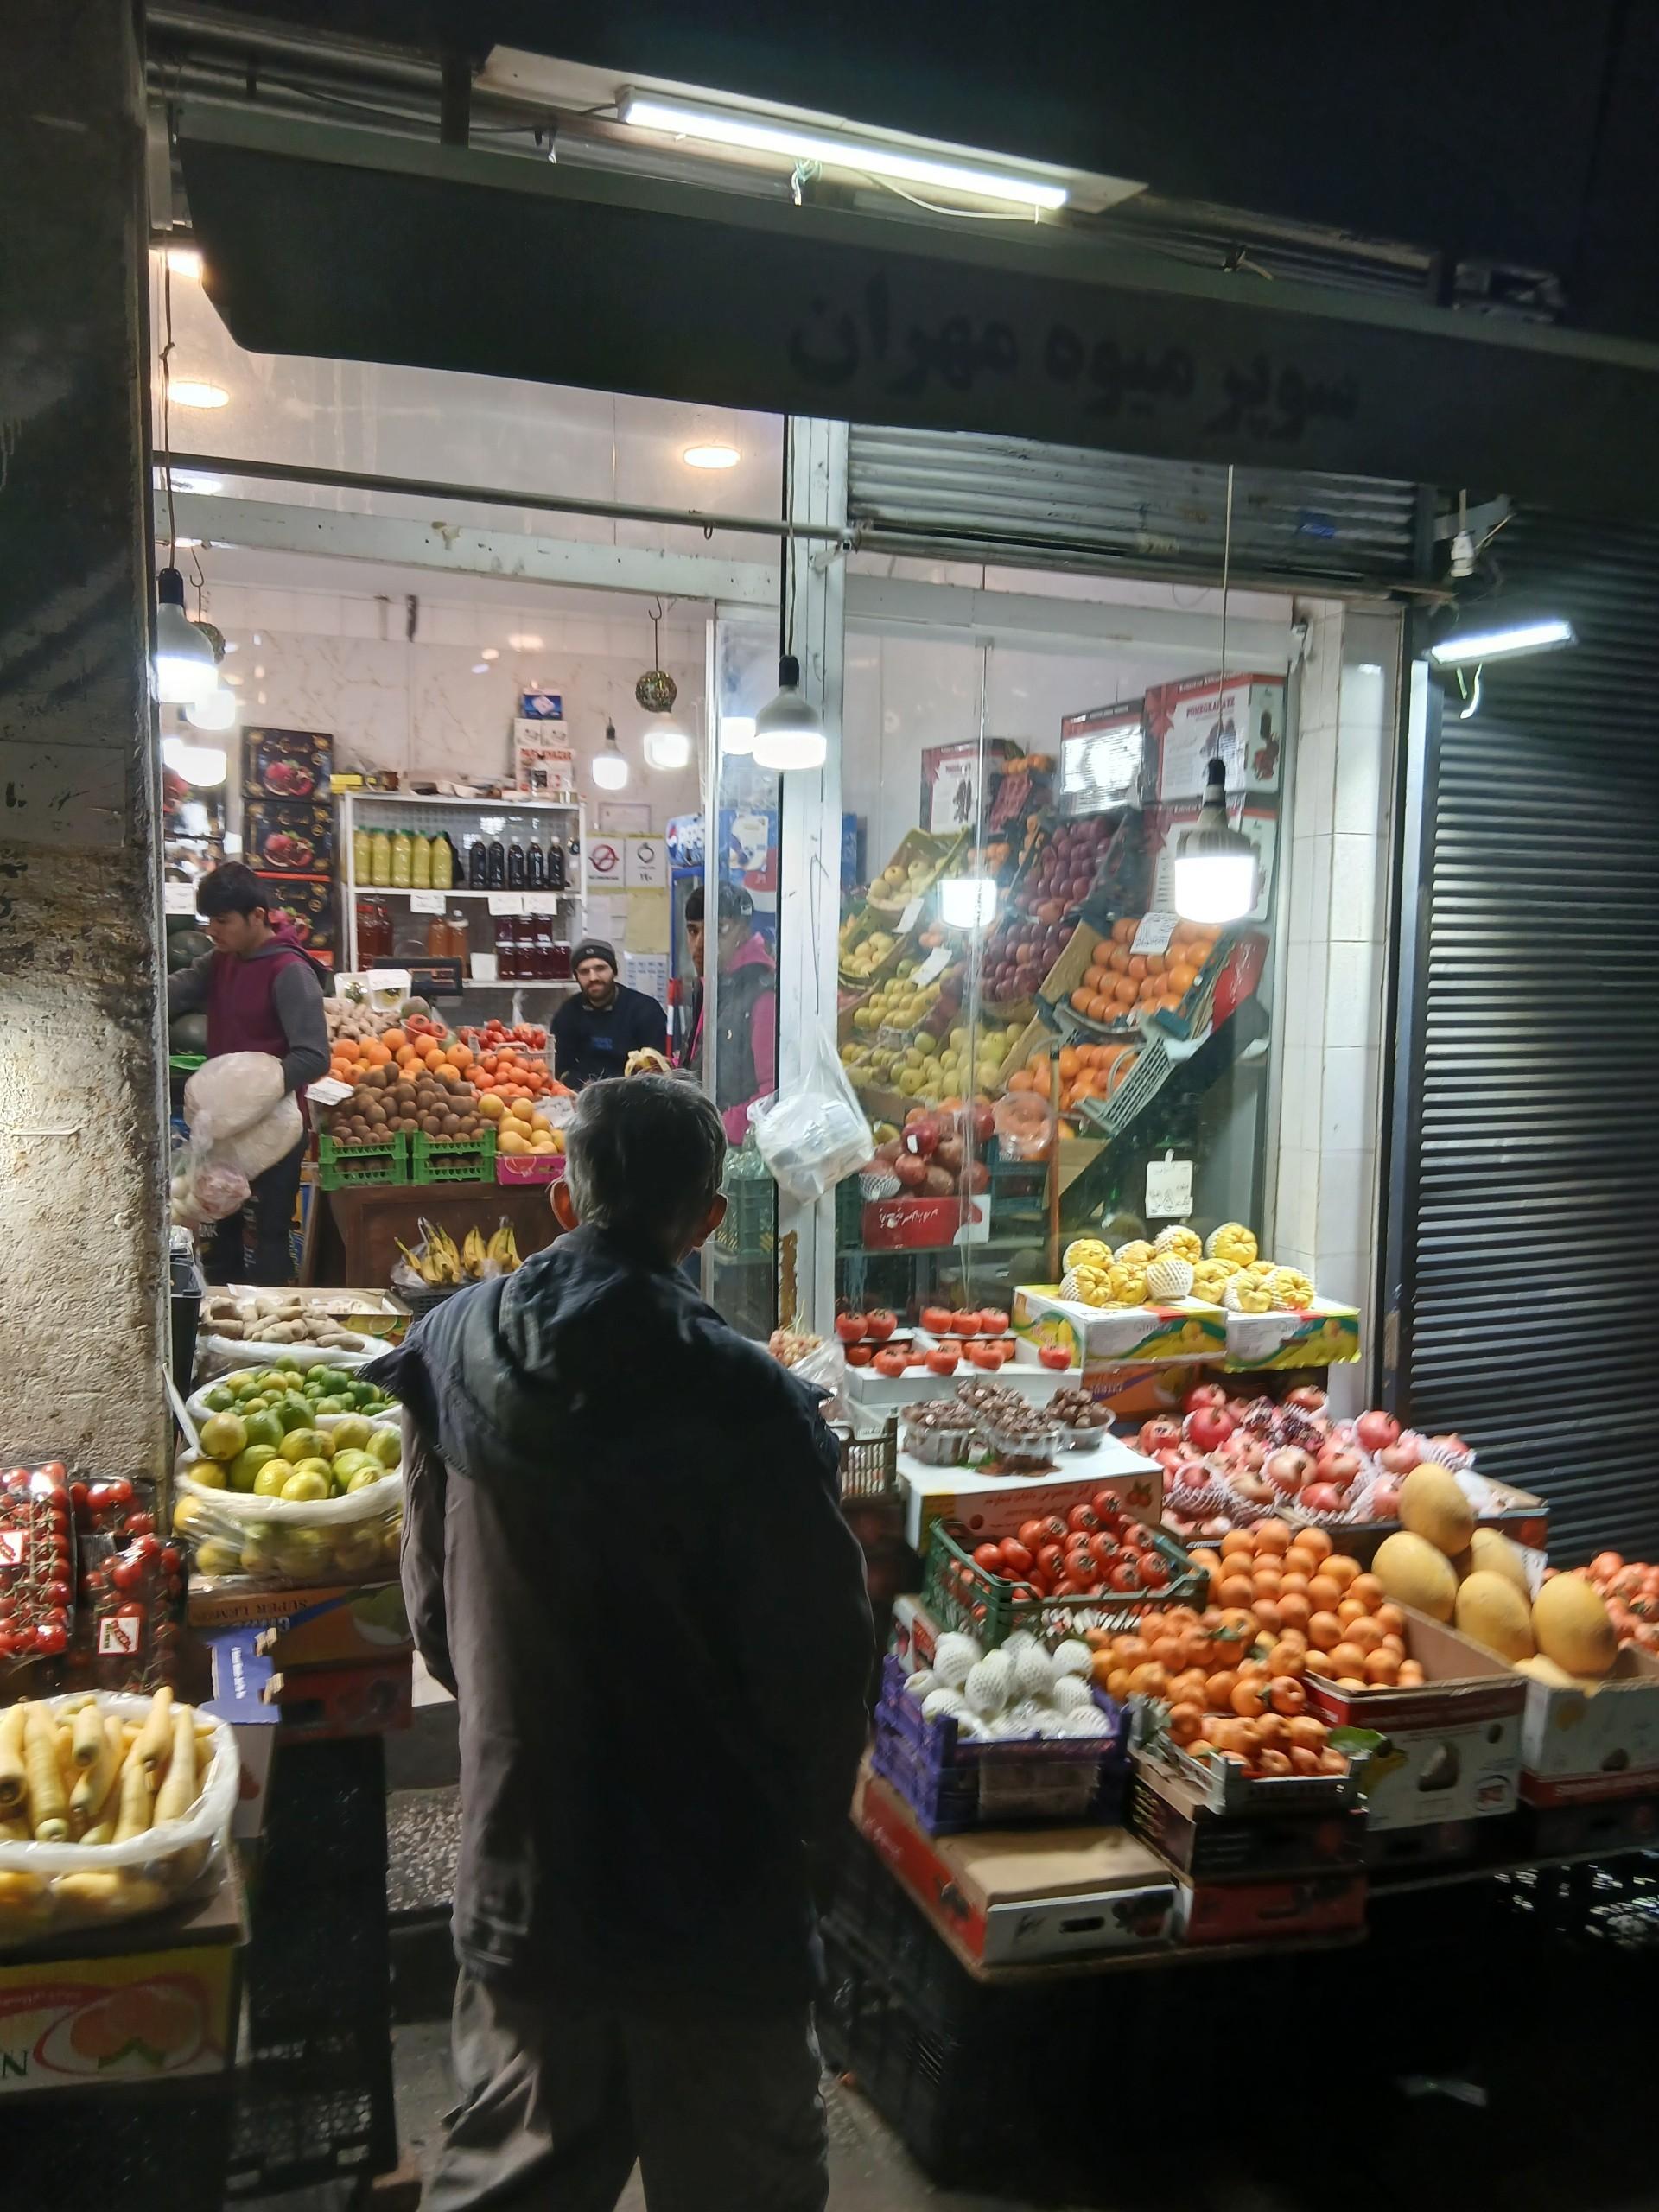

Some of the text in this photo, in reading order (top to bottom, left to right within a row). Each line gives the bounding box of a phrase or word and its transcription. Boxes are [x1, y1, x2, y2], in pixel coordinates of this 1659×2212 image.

[787, 270, 1360, 445] سوپر میوه مهران
